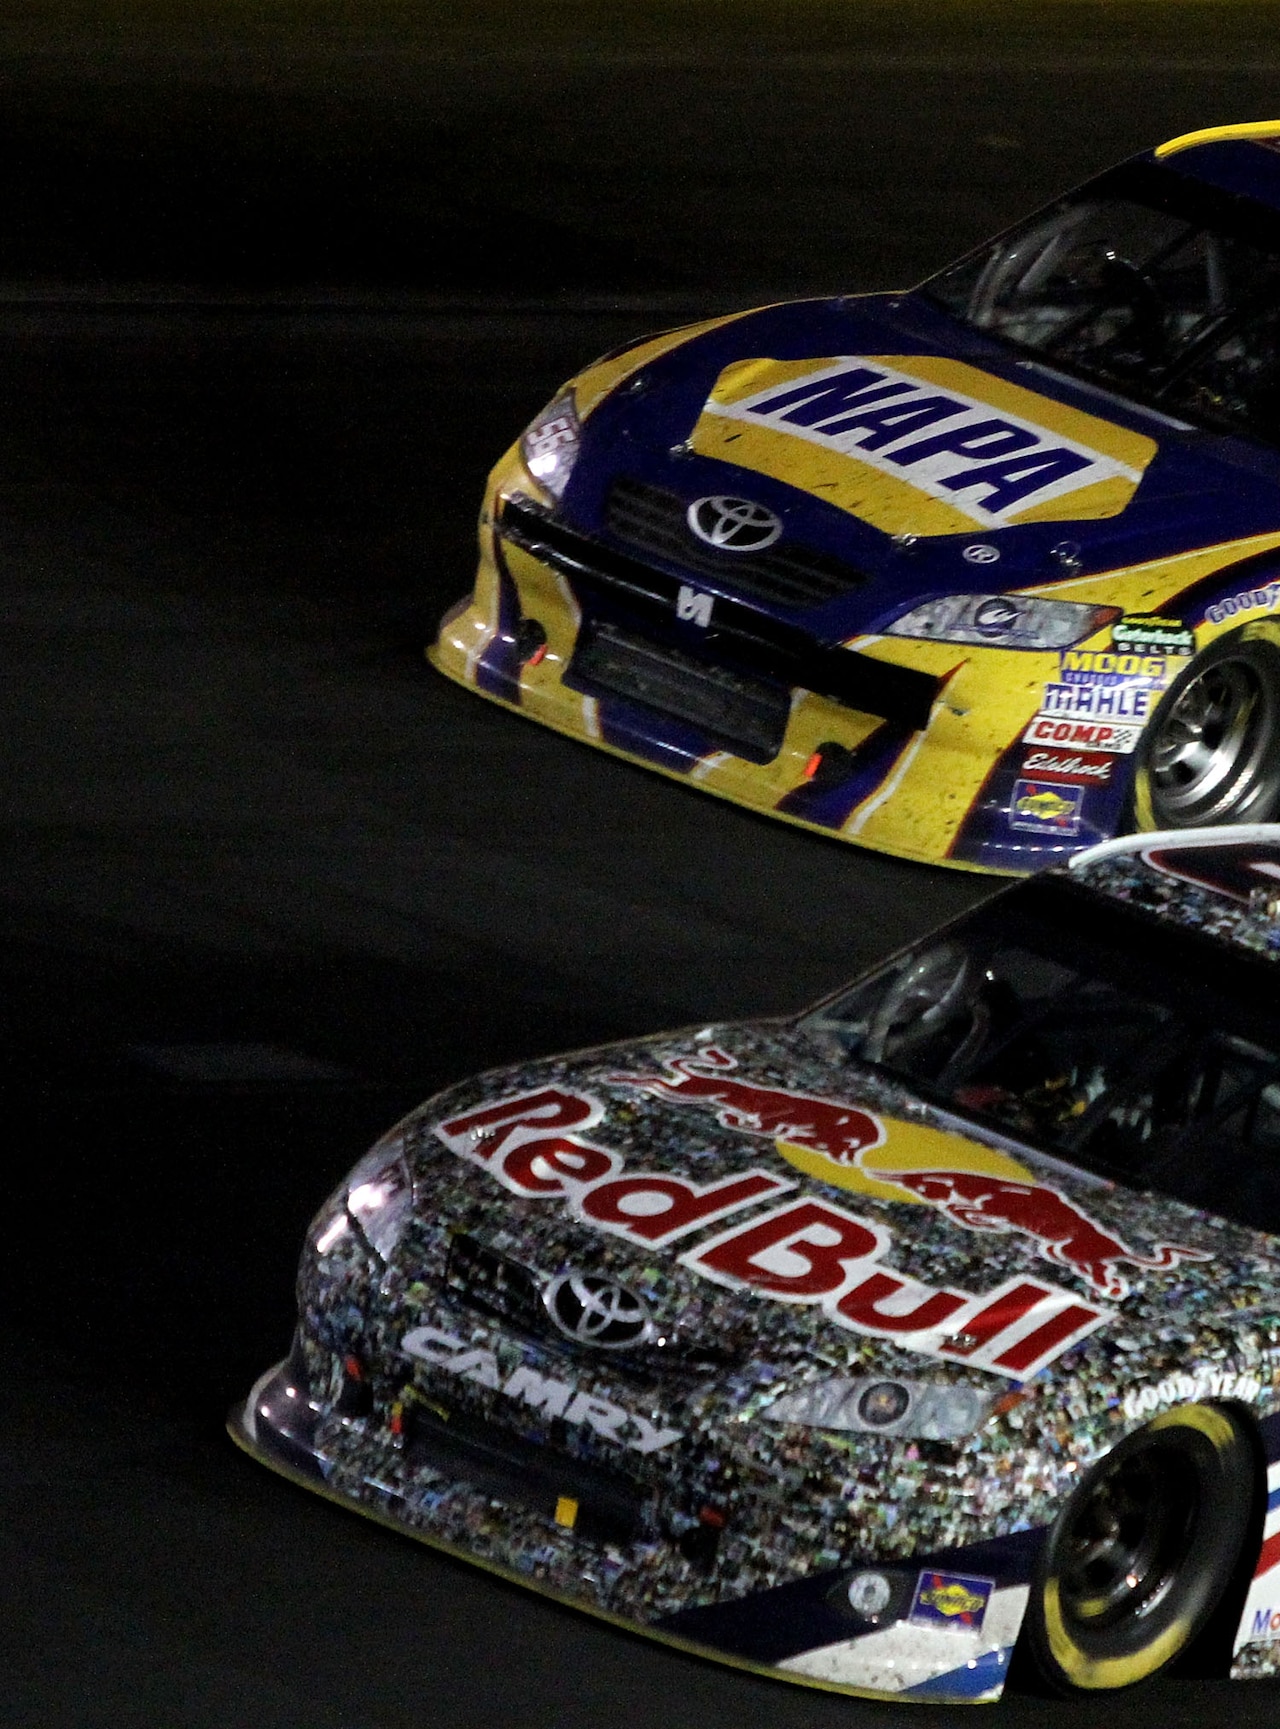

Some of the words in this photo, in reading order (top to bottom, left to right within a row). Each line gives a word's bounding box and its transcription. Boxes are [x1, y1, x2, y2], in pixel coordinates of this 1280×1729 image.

[747, 367, 1095, 513] NAPA
[1044, 683, 1150, 717] MAHLE
[1061, 652, 1166, 677] MOOG
[1034, 721, 1114, 745] COMP
[436, 1087, 790, 1246] Red
[690, 1203, 1108, 1373] Bull
[400, 1325, 685, 1453] CAMRY
